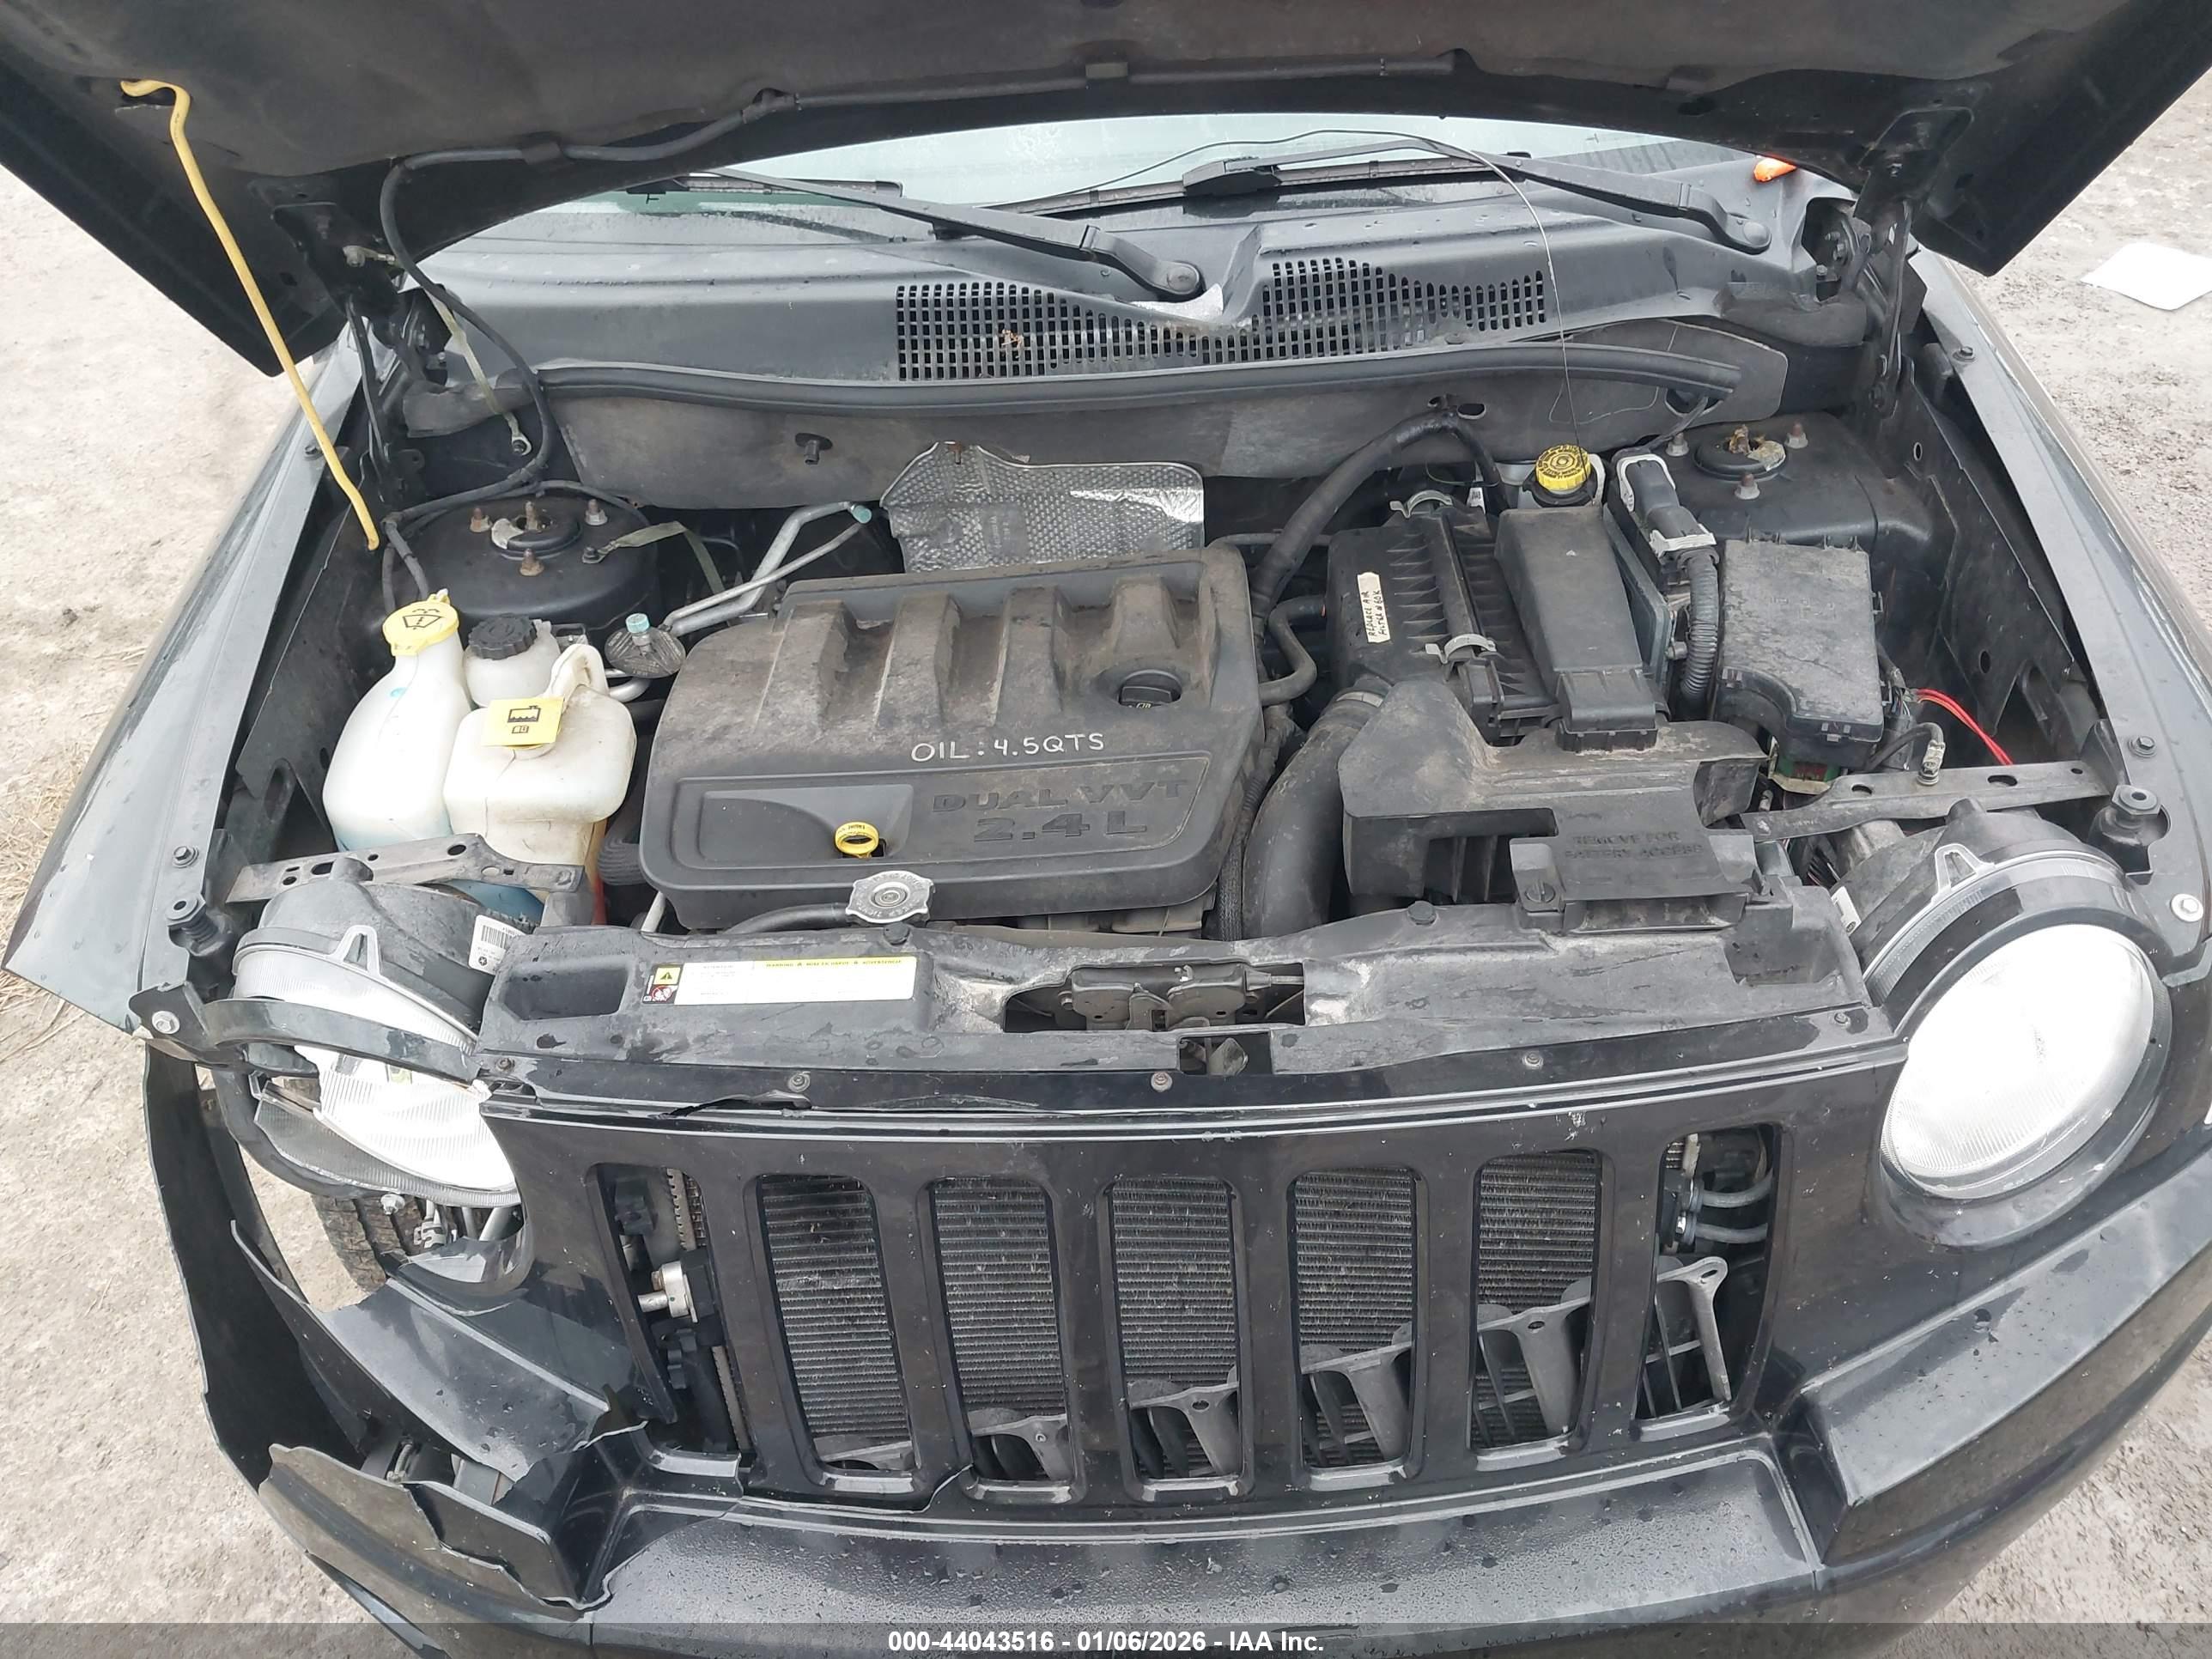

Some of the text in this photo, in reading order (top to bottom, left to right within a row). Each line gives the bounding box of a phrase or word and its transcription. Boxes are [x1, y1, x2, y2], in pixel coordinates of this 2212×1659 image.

[994, 732, 1105, 757] 4.5QTS
[933, 779, 1188, 813] DUAL VVT
